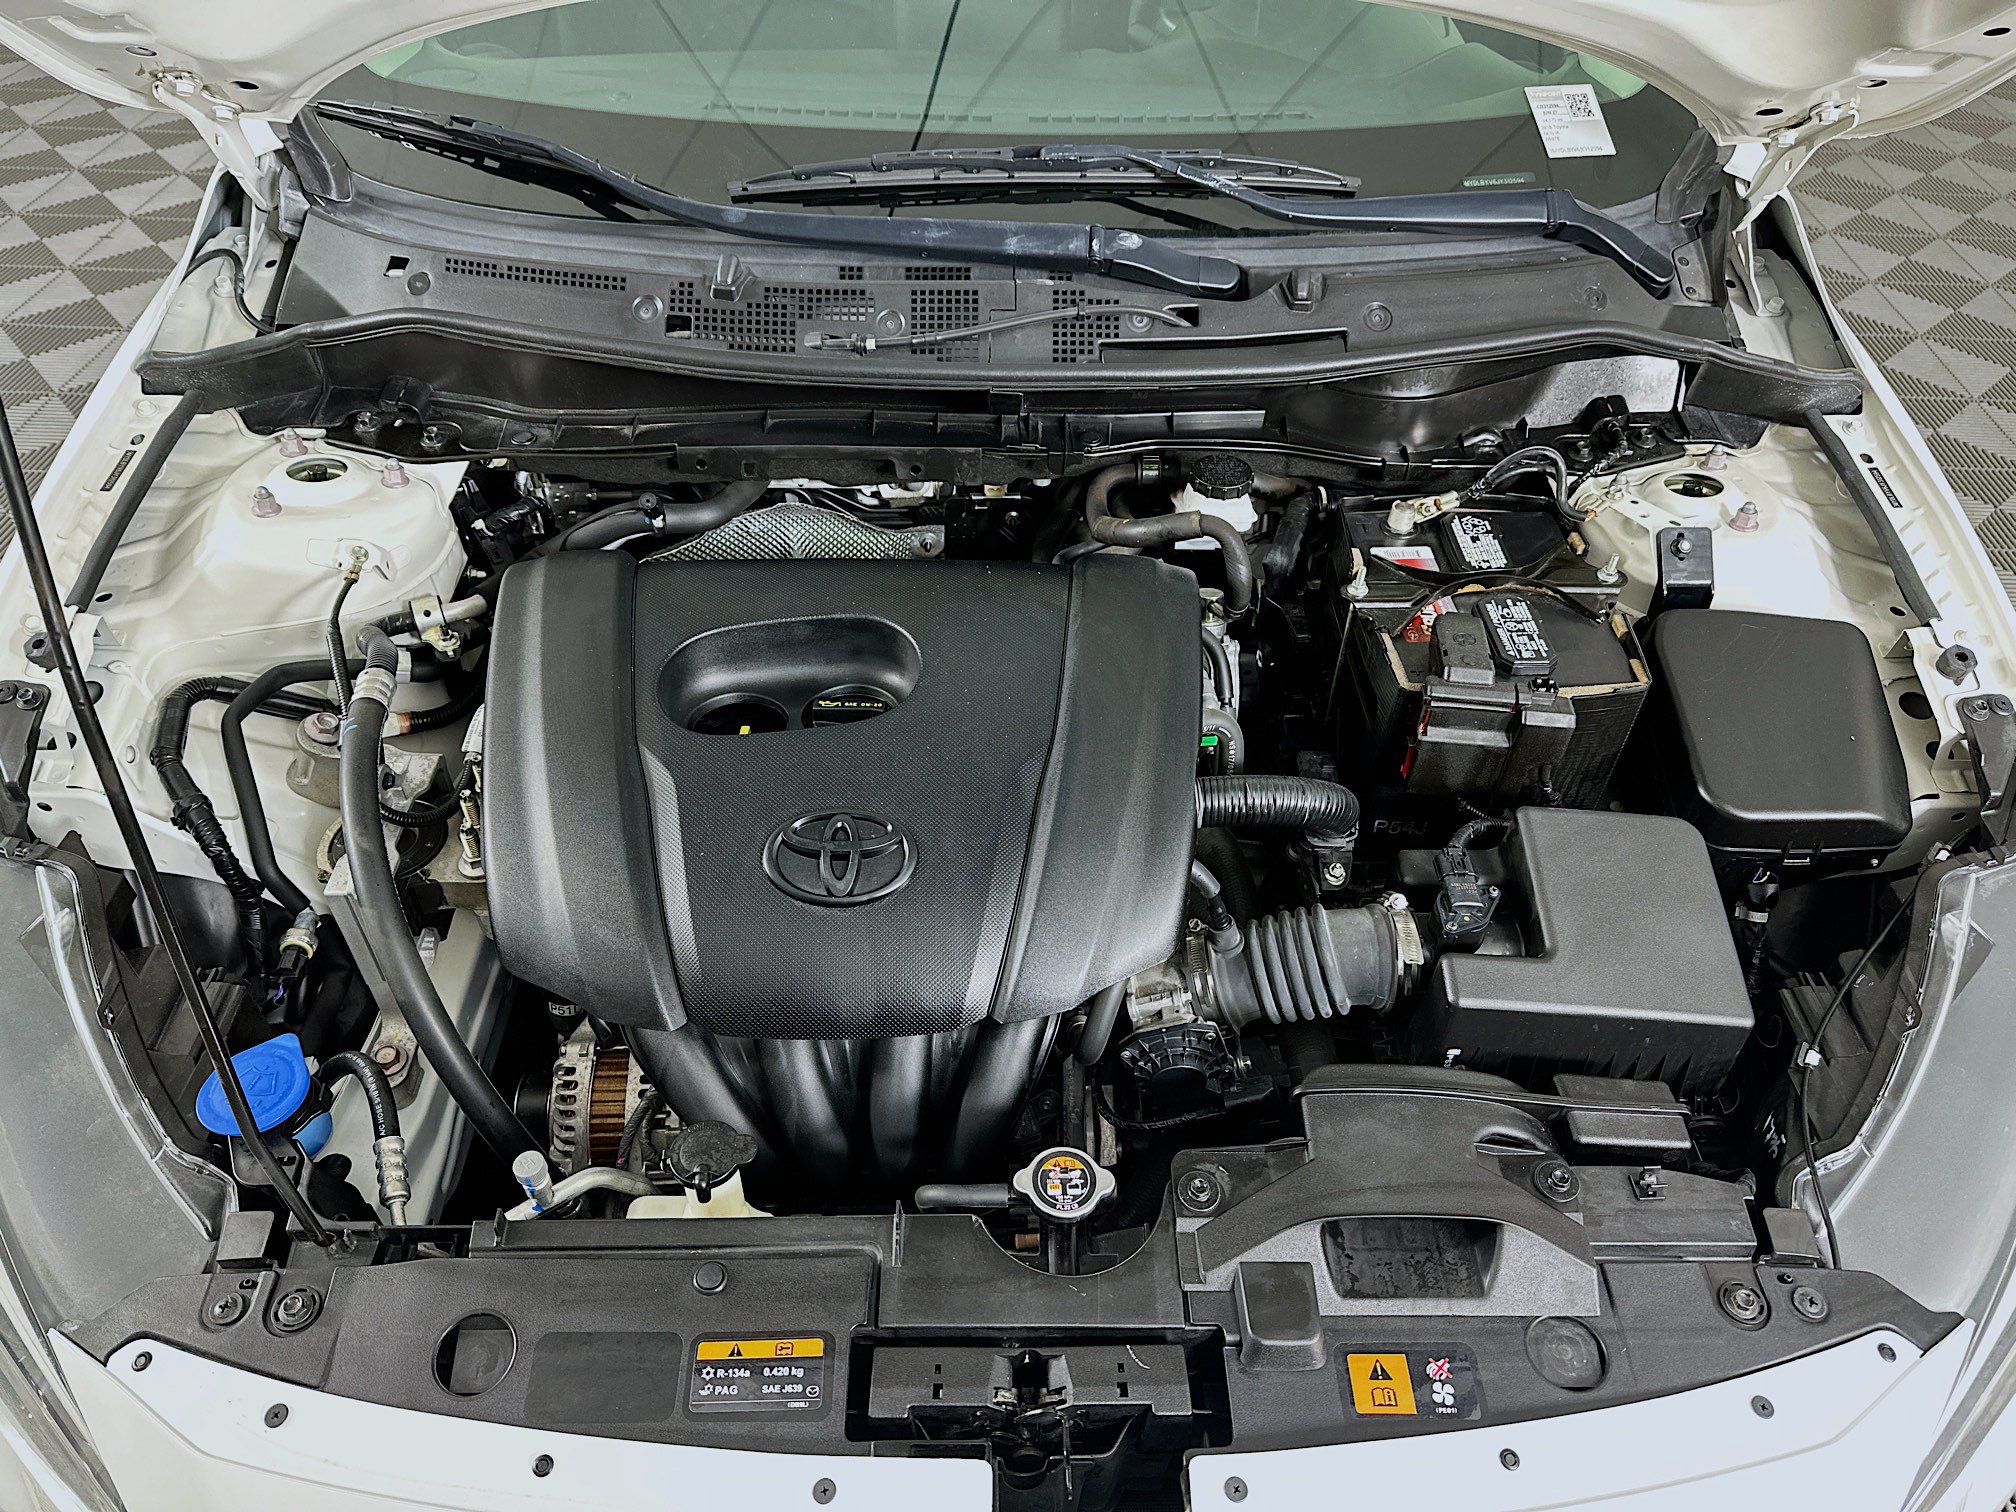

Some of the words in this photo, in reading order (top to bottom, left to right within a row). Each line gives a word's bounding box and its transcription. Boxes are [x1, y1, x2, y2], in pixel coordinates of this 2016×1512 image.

[1373, 819, 1429, 835] P54J
[375, 1103, 385, 1124] HOSE
[716, 1368, 751, 1378] R-134a
[763, 1367, 789, 1377] 0.420
[790, 1366, 805, 1378] kg
[714, 1385, 739, 1396] PAG
[761, 1384, 781, 1394] SAE
[782, 1383, 803, 1393] J639
